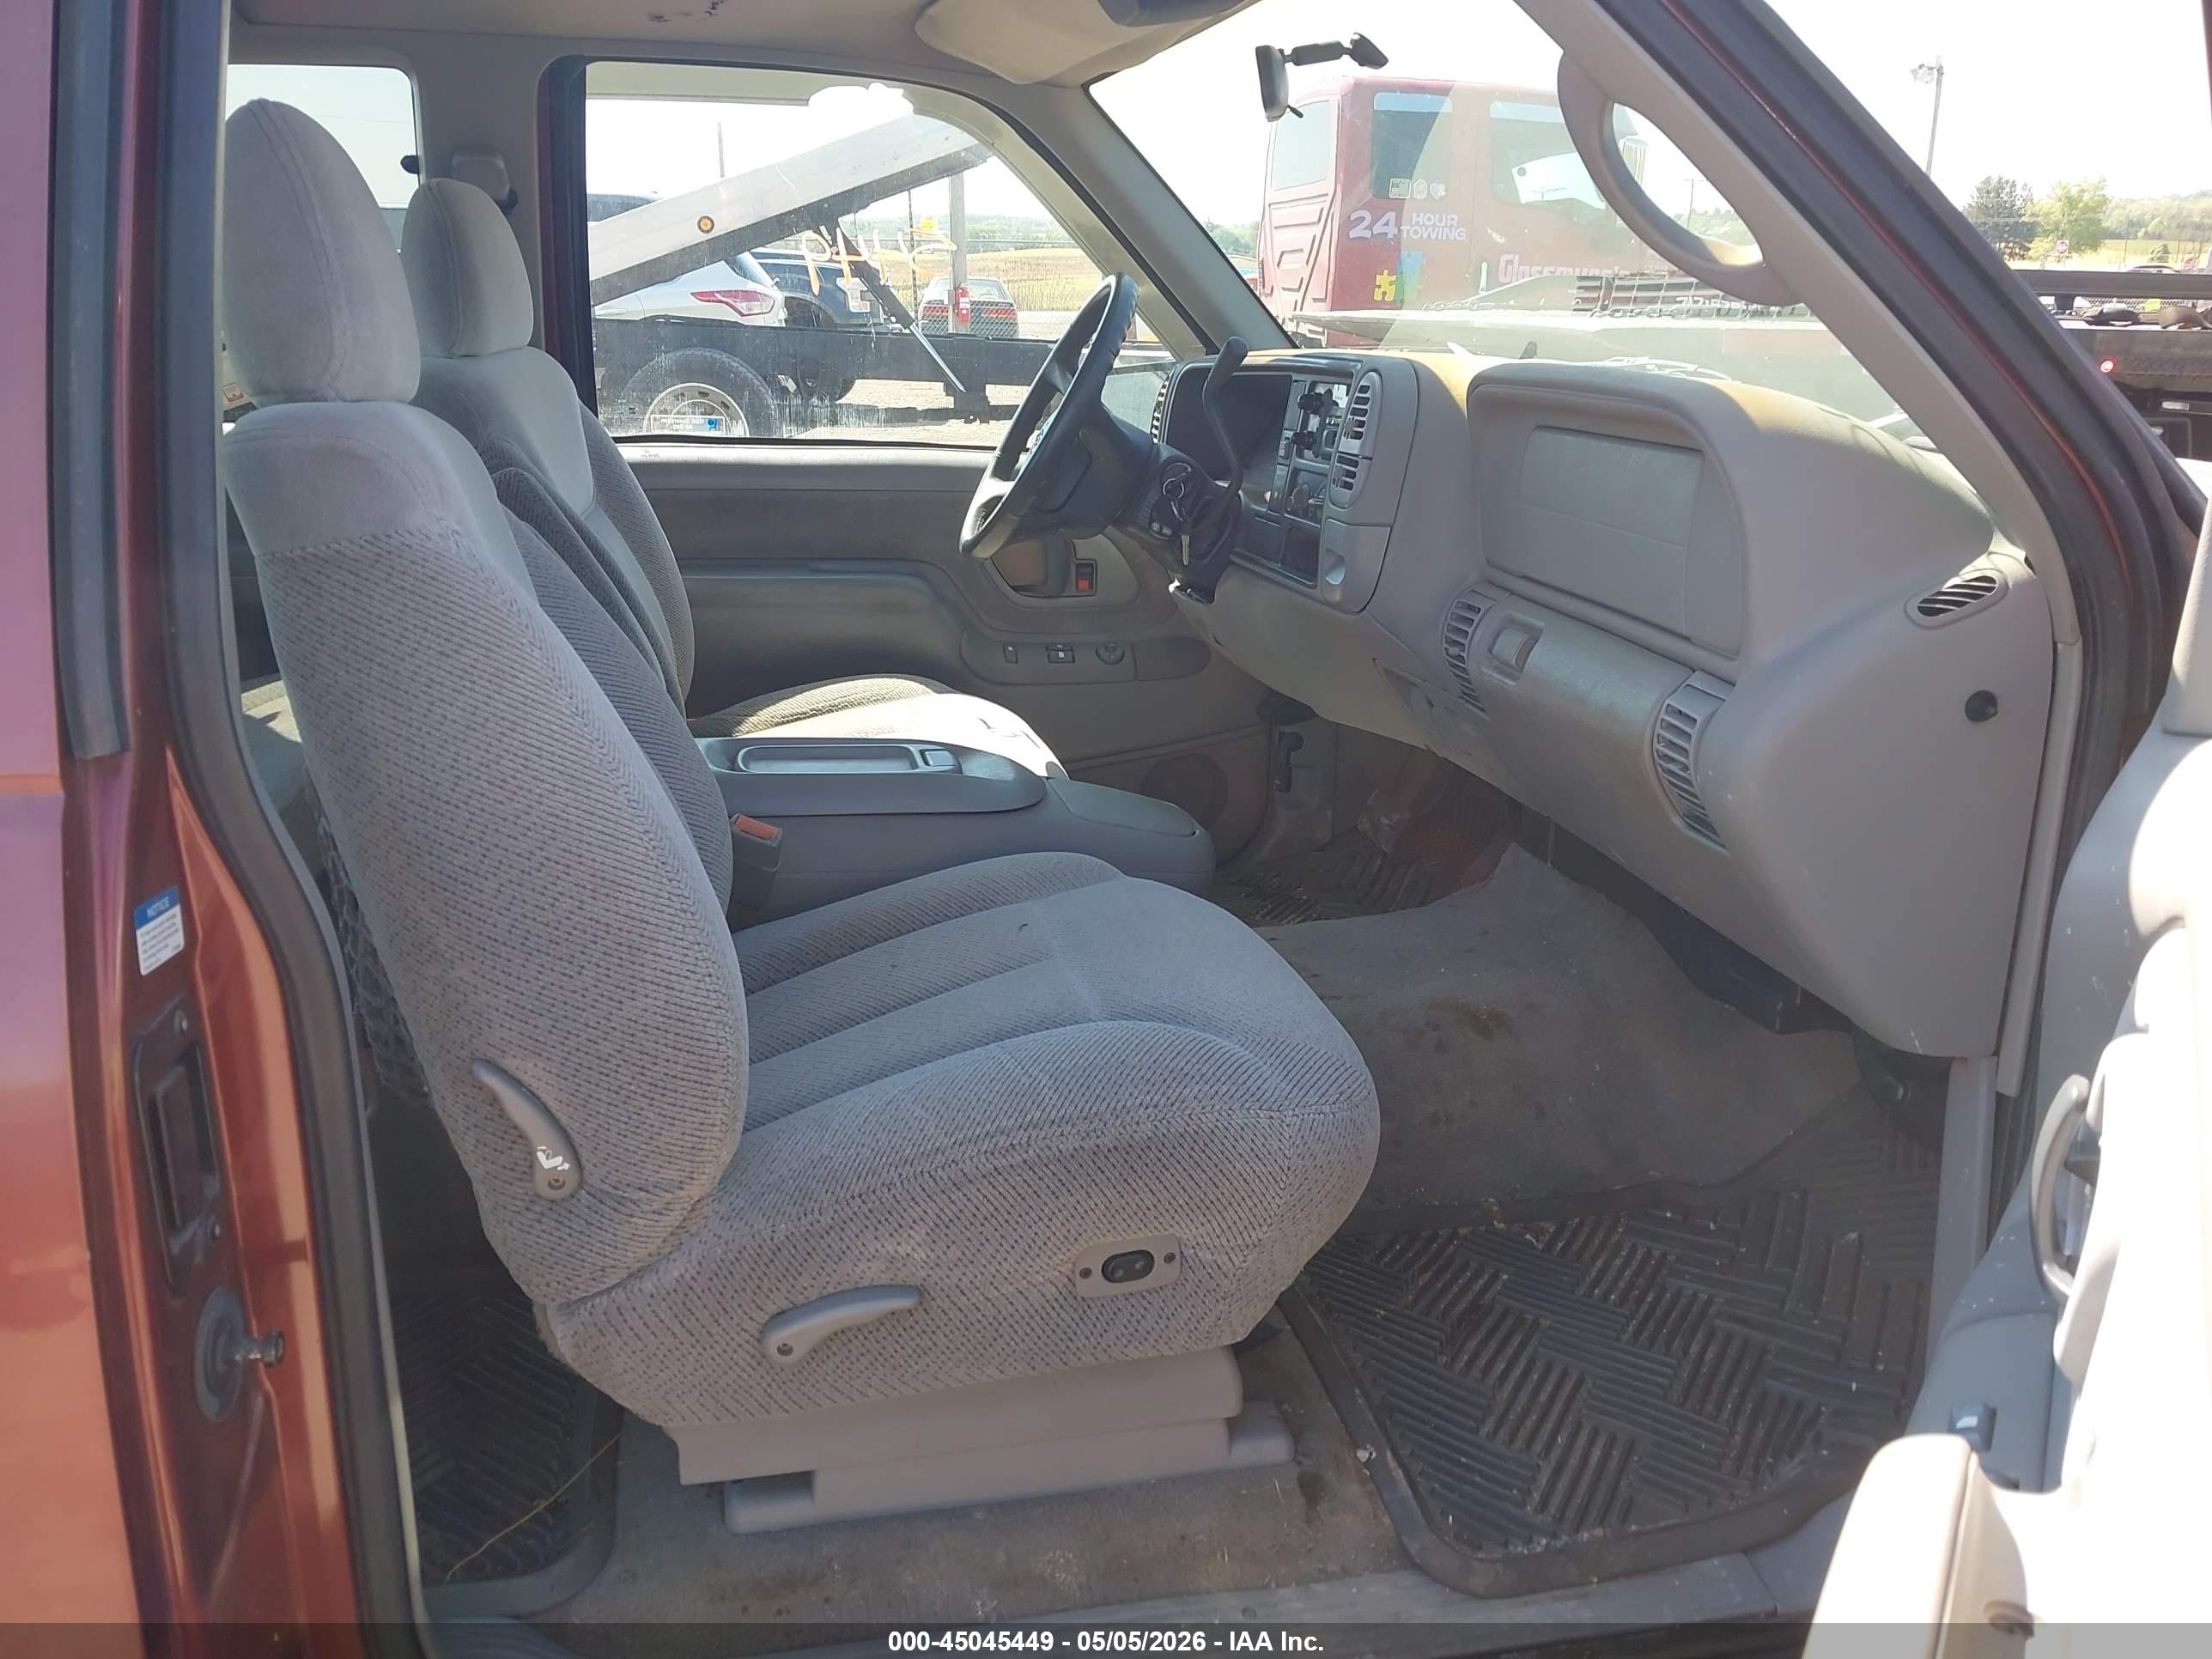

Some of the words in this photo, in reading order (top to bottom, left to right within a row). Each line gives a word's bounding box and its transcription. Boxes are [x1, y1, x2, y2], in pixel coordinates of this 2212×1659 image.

[1349, 210, 1398, 240] 24
[1411, 212, 1458, 227] HOUR
[1400, 226, 1467, 241] TOWING
[146, 896, 170, 920] NOTICE
